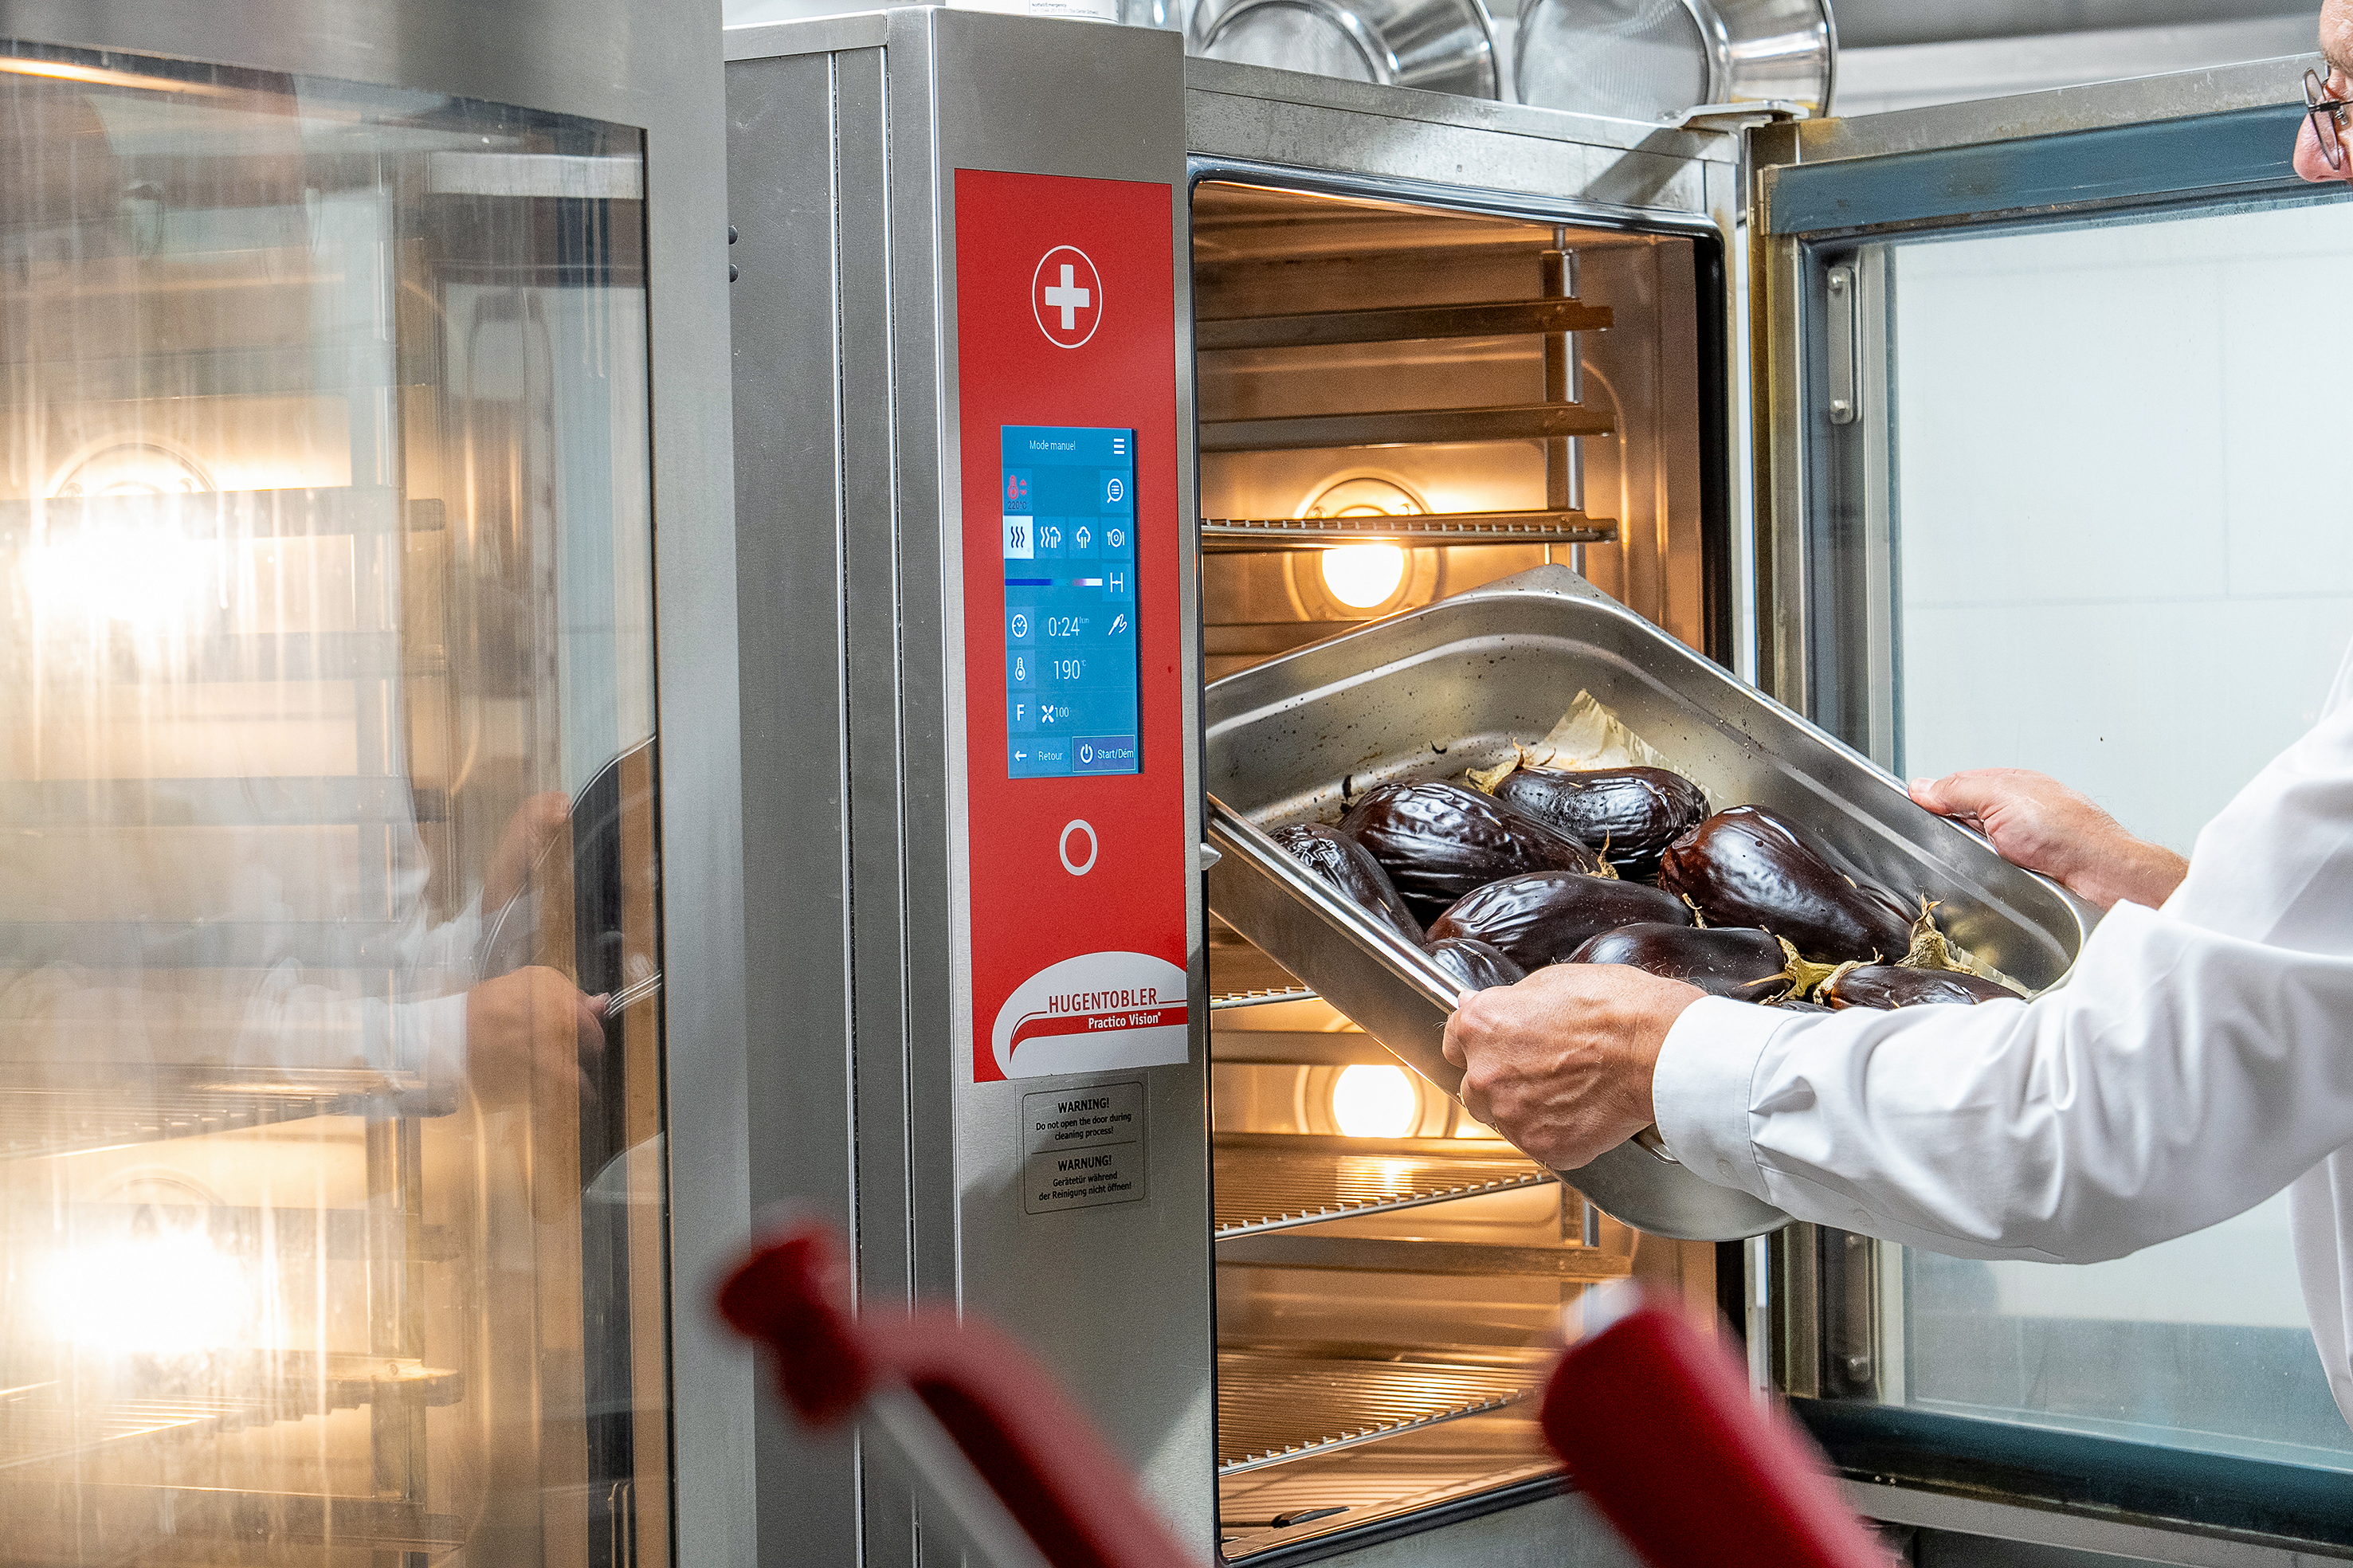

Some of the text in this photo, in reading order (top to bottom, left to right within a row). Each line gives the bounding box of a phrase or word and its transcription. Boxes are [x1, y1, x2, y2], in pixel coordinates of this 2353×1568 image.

[1029, 440, 1076, 450] Mode manuel
[1048, 617, 1080, 637] 0:24
[1053, 660, 1080, 680] 190
[1017, 704, 1069, 721] F 100
[1038, 747, 1134, 761] Retour Start/Dém
[1049, 987, 1158, 1013] HUGENTOBLER
[1088, 1015, 1127, 1029] Practico
[1057, 1097, 1110, 1114] WARNING!
[1036, 1122, 1046, 1131] Do
[1047, 1120, 1060, 1129] not
[1060, 1119, 1078, 1129] open
[1079, 1117, 1091, 1126] the
[1109, 1112, 1132, 1123] during
[1054, 1126, 1114, 1141] cleaning process!
[1057, 1154, 1112, 1171] WARNUNG!
[1053, 1170, 1118, 1187] Gerätetür während
[1038, 1182, 1132, 1201] der Reinigung nicht öffnen!
